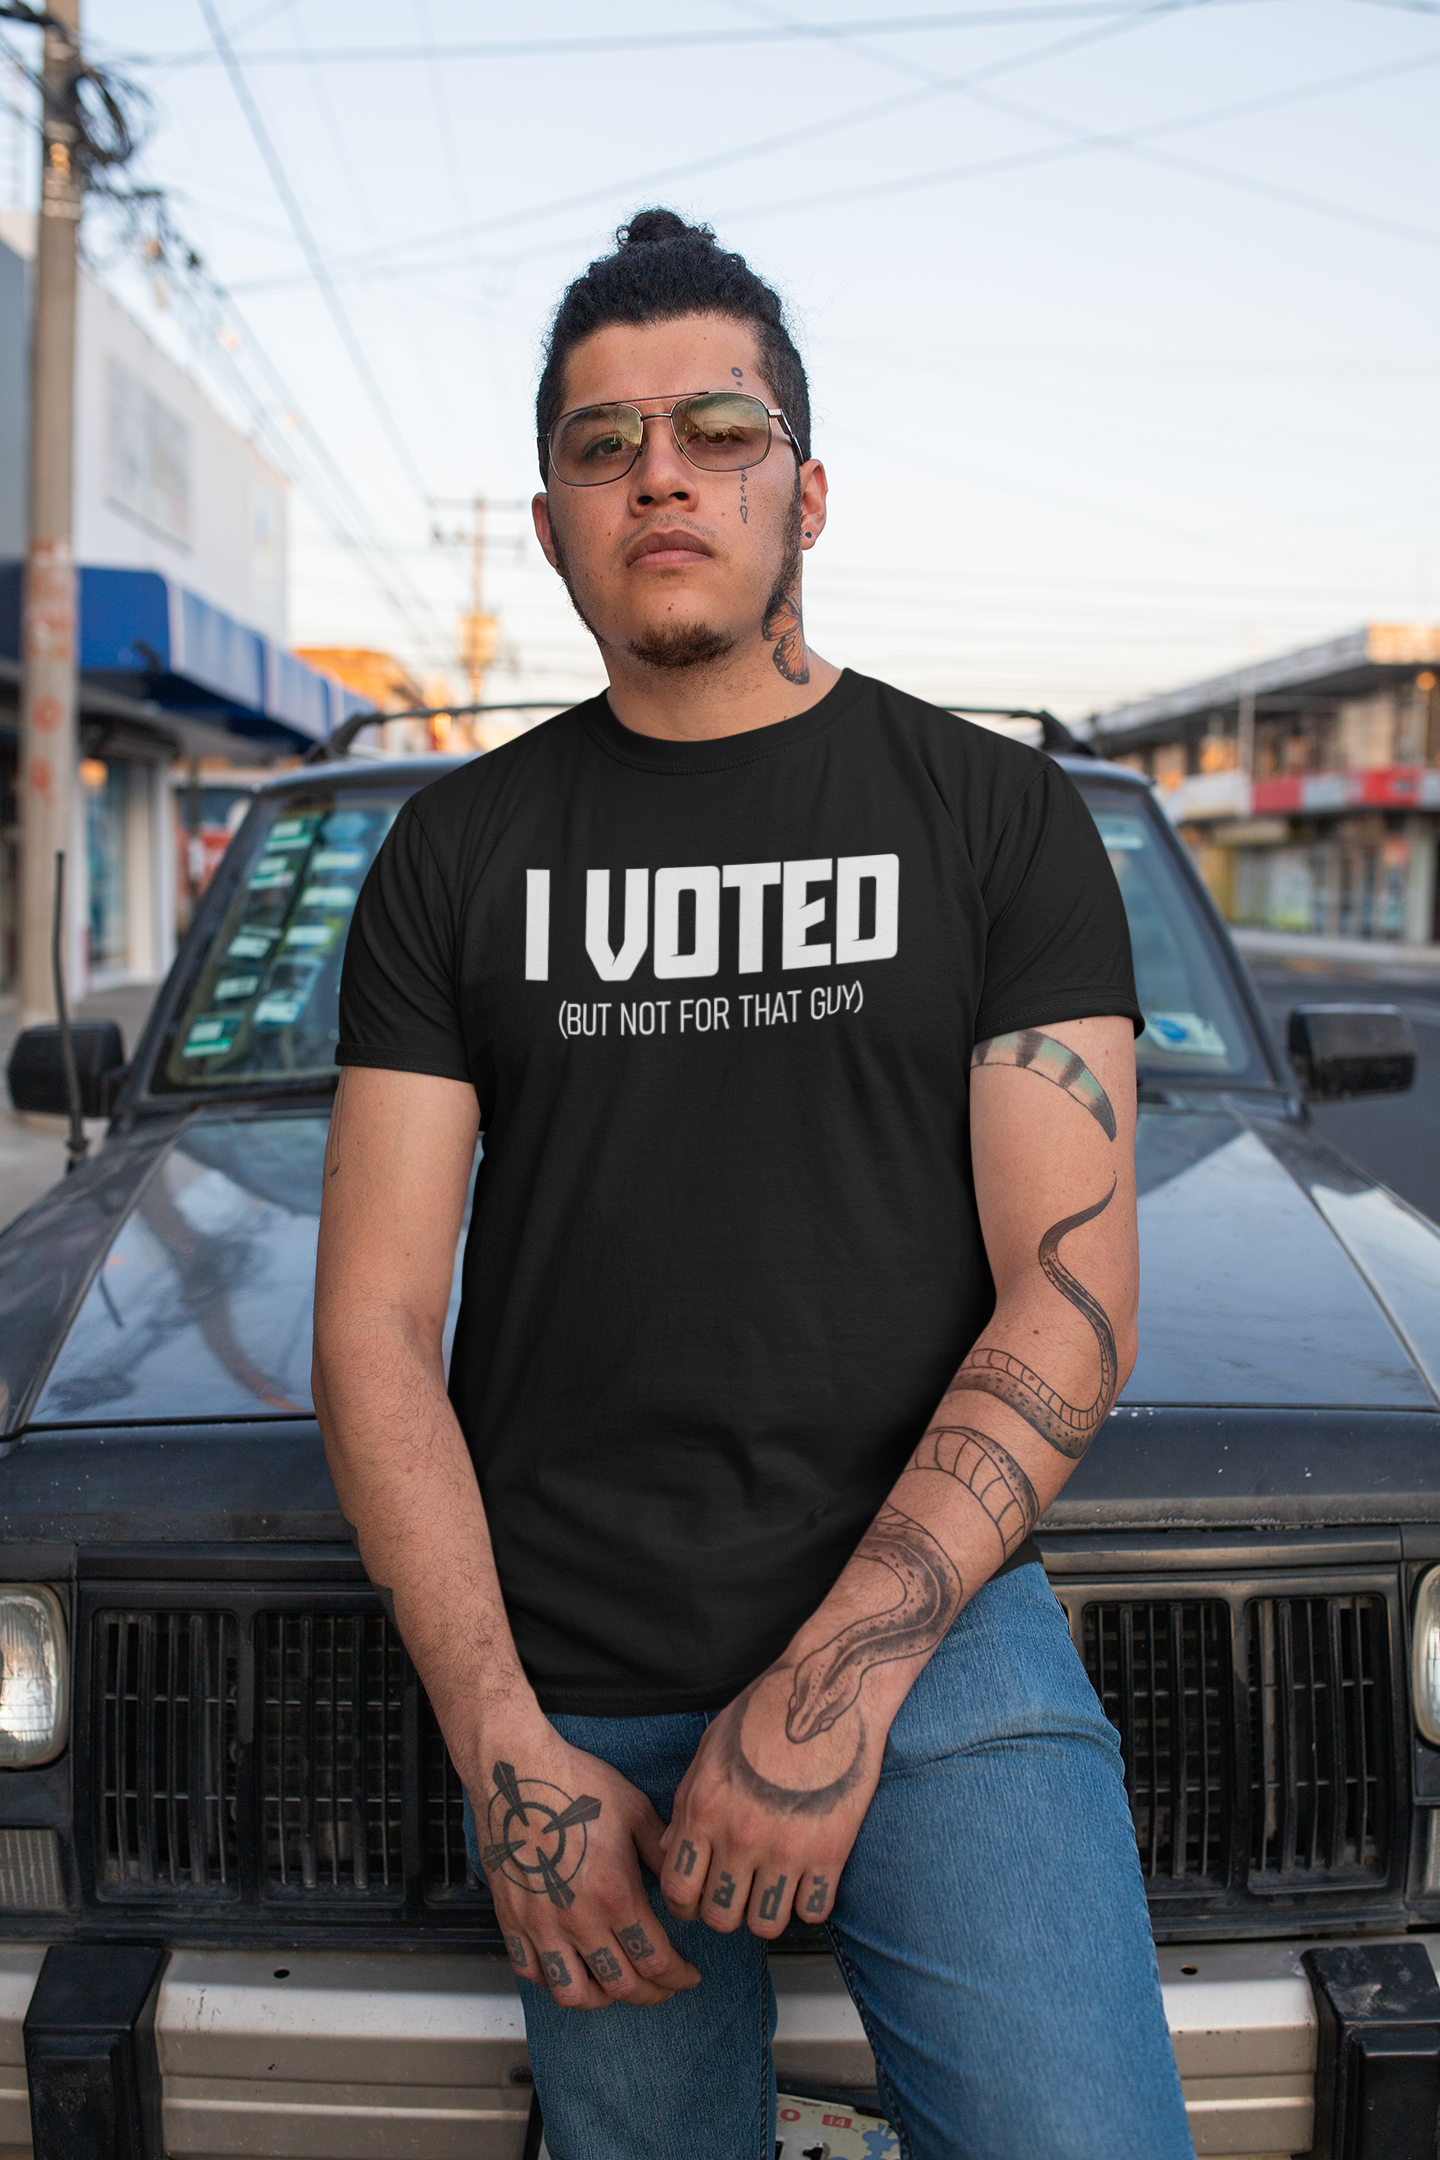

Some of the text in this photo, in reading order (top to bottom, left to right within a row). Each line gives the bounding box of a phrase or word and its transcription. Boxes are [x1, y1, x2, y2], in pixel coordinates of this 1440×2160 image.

[526, 854, 899, 981] I VOTED
[558, 980, 864, 1039] (BUT NOT FOR THAT GUY)
